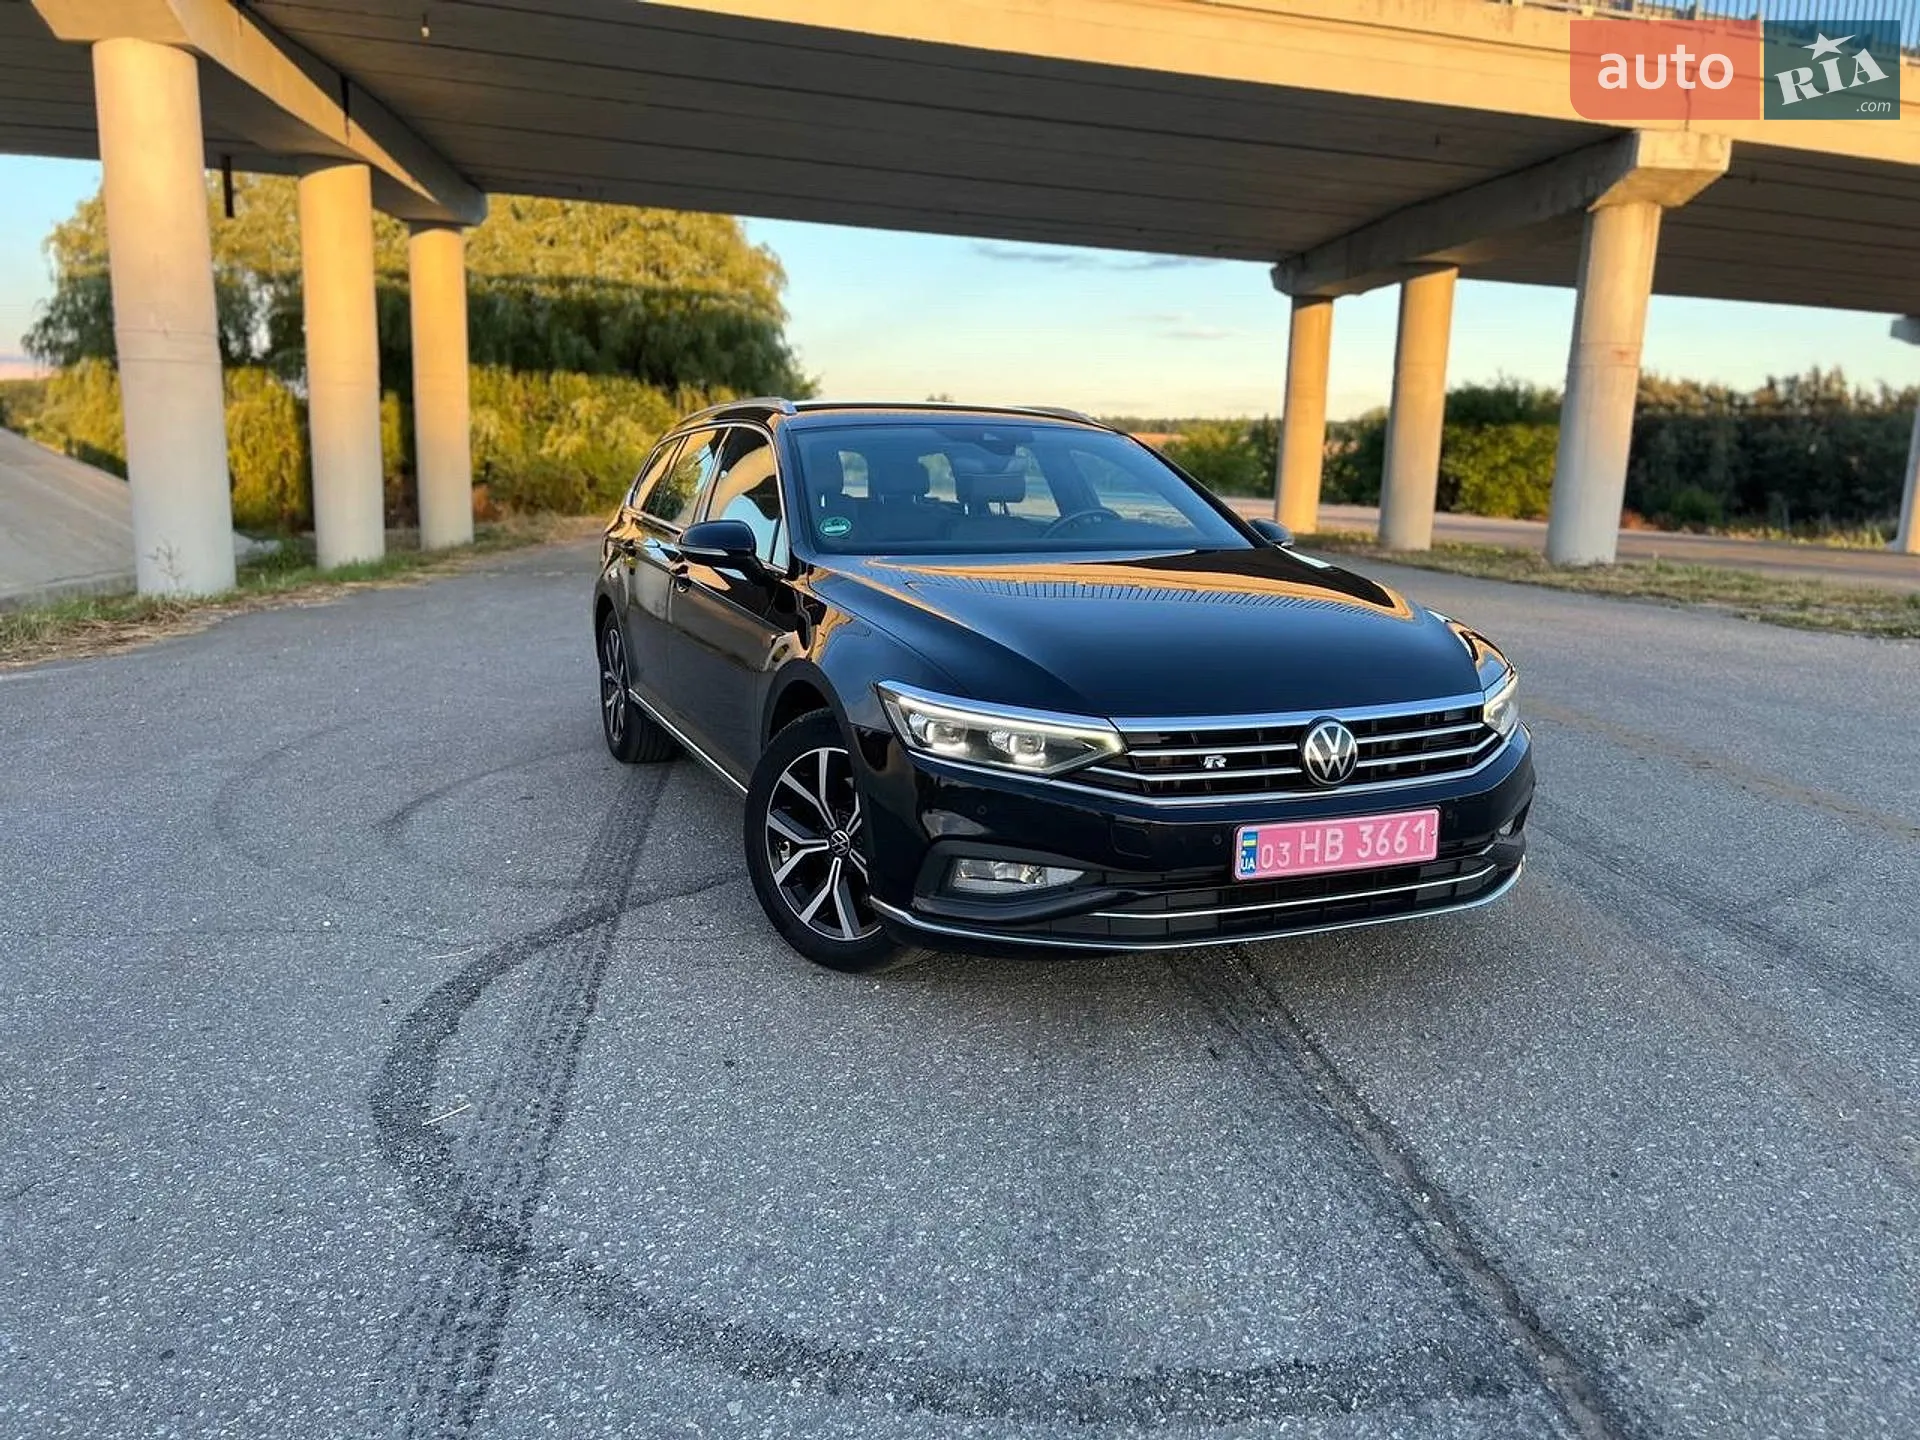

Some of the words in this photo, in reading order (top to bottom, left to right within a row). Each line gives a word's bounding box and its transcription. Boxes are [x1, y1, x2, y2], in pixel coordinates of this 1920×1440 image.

[1261, 842, 1292, 869] 03
[1299, 827, 1344, 864] HB
[1356, 818, 1428, 858] 3661
[1241, 857, 1255, 870] UA
